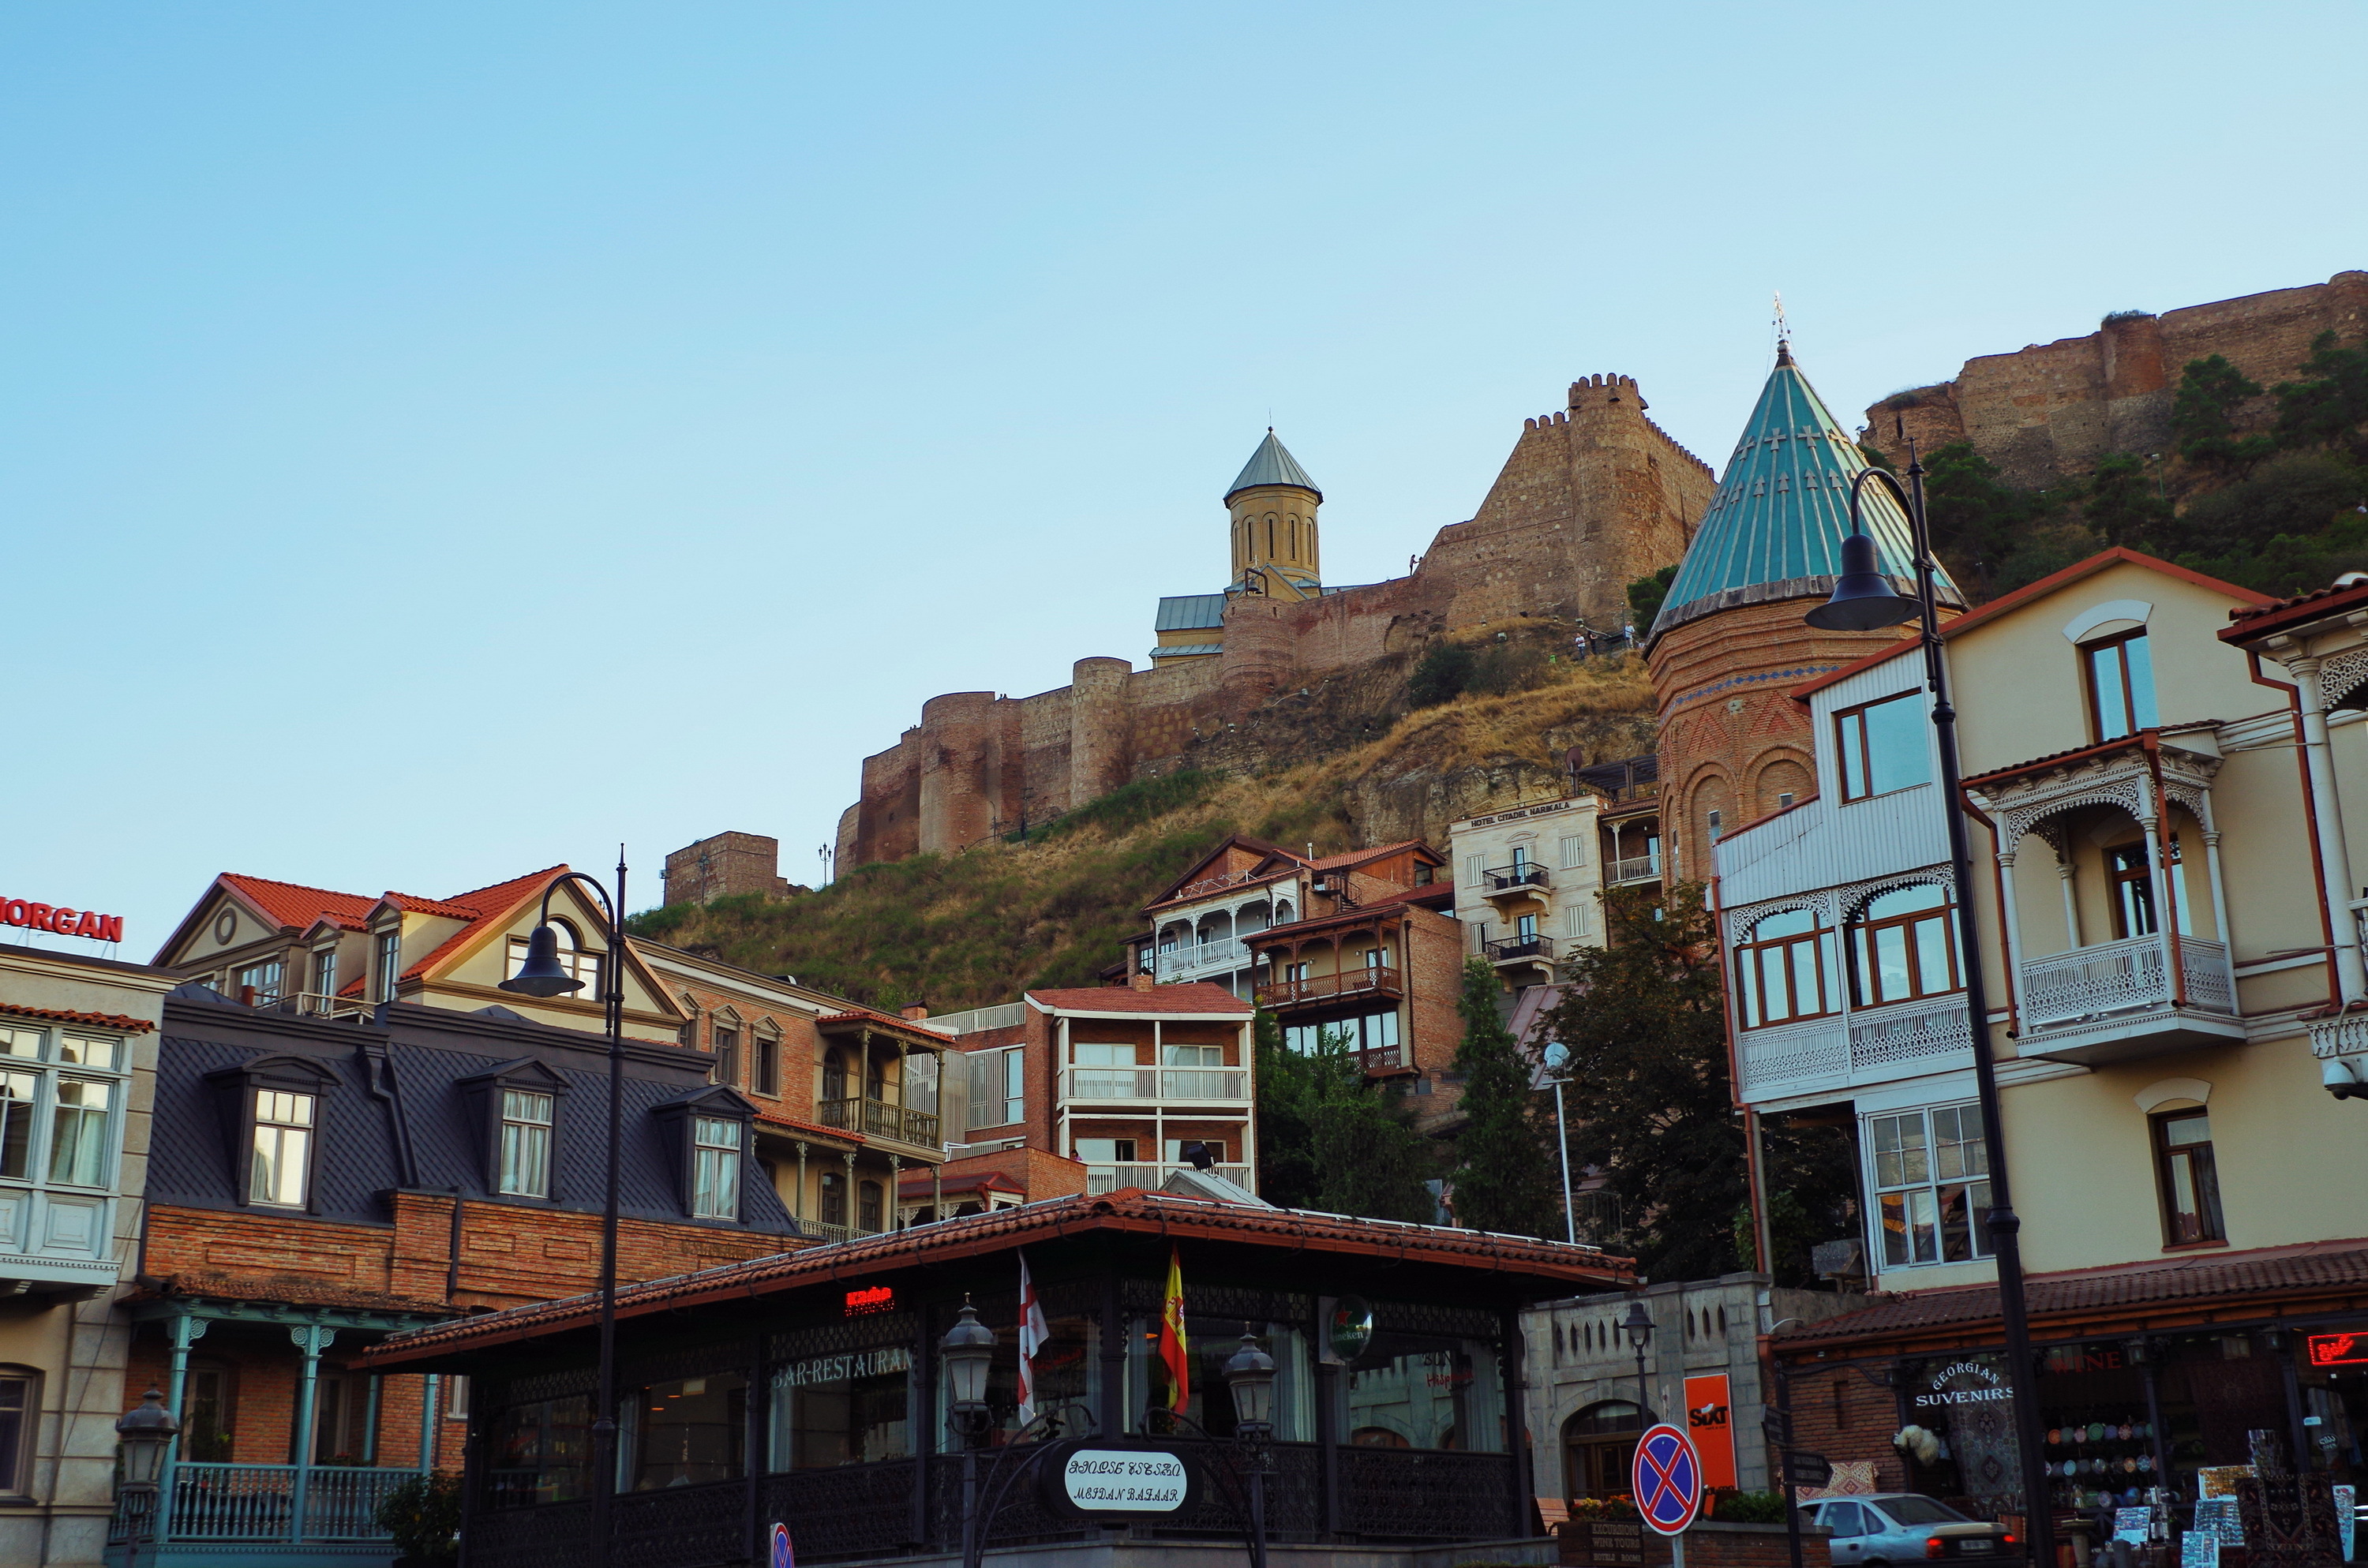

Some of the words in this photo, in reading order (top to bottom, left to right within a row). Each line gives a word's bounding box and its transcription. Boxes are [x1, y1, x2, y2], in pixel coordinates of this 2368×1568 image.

[1471, 817, 1495, 827] HOTEL
[1497, 810, 1527, 822] CITADEL
[1530, 802, 1570, 816] NARIKALA
[2048, 1350, 2123, 1376] WINE
[1932, 1362, 2000, 1390] GEORGIAN
[1916, 1387, 2014, 1407] SUVENIRS
[1073, 1487, 1125, 1500] MEIDAN
[1126, 1488, 1178, 1502] BAZAAR
[1591, 1523, 1639, 1536] EXCURSIONS
[1591, 1537, 1613, 1547] WINE
[1614, 1538, 1640, 1548] TOURS
[1593, 1553, 1616, 1562] HOTELS
[1621, 1554, 1642, 1562] ROOMS
